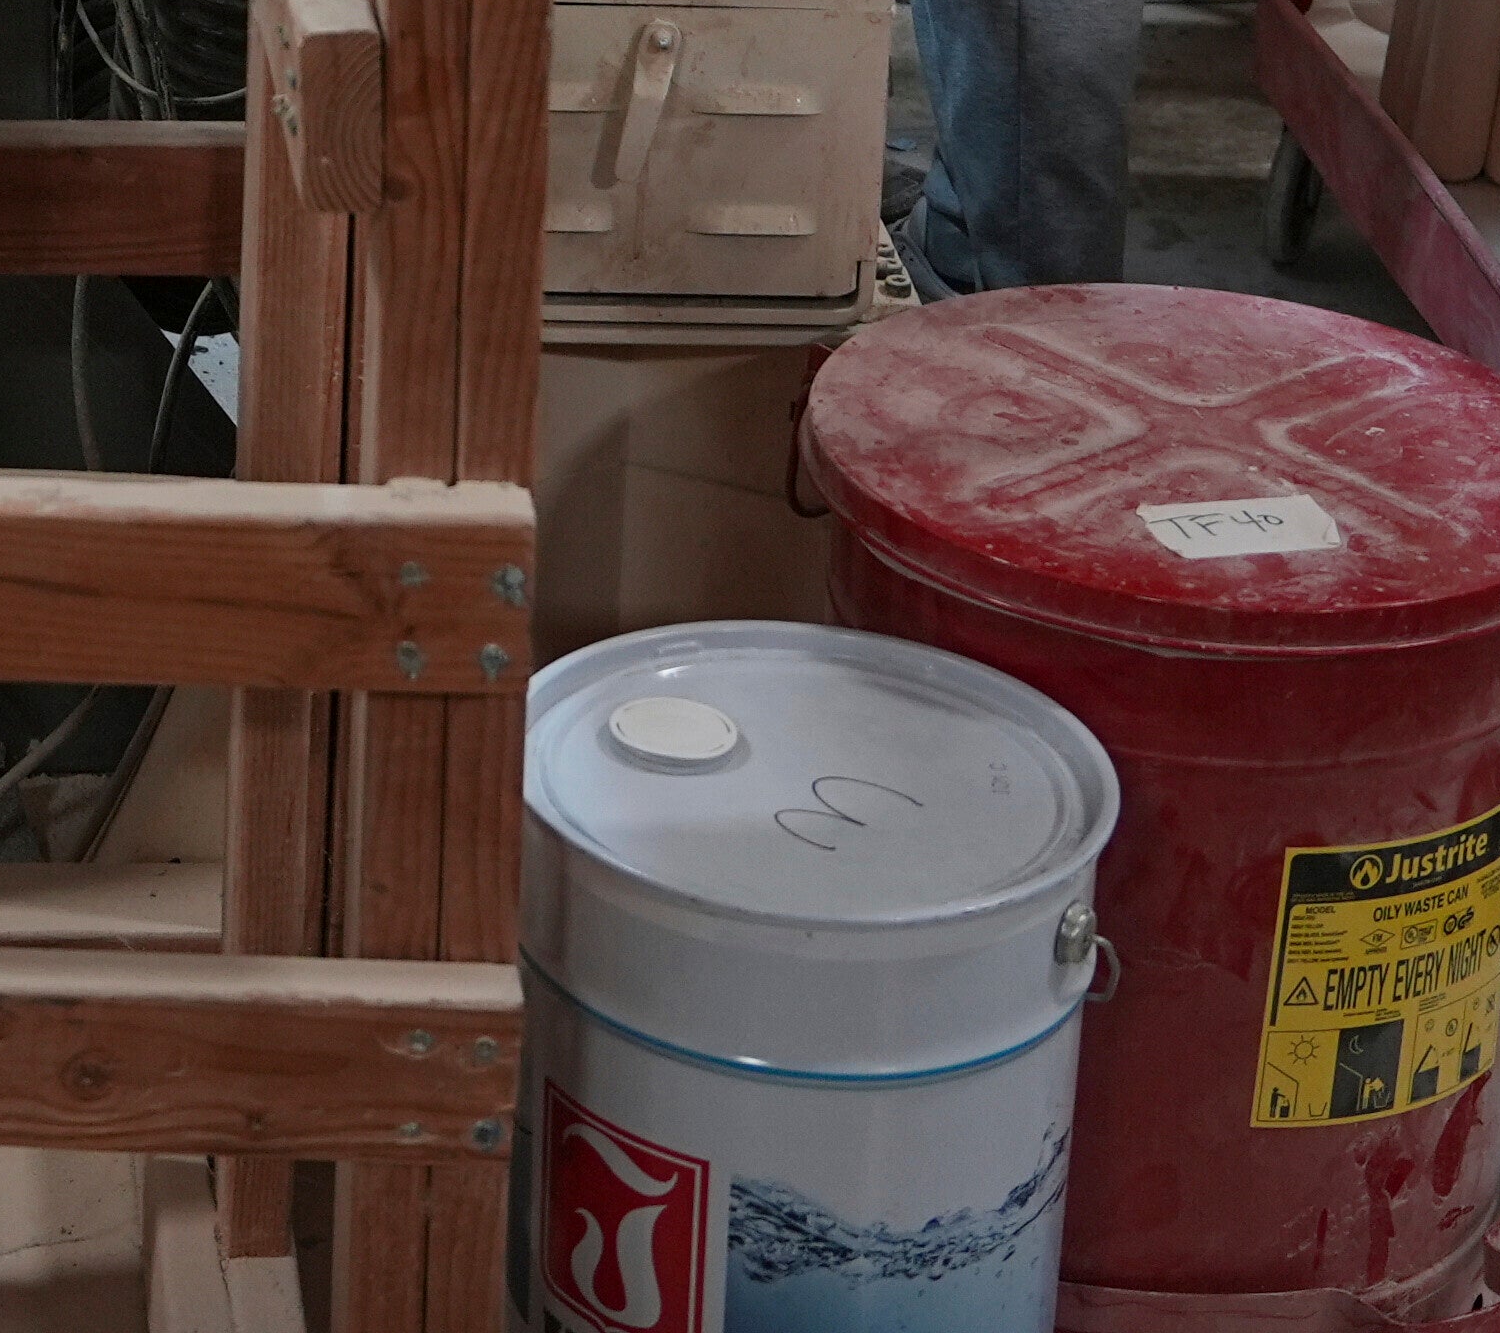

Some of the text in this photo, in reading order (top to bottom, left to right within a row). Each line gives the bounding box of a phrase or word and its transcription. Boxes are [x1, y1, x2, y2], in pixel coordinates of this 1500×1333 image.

[1385, 832, 1489, 884] Justrite
[1305, 905, 1337, 915] MODEL
[1373, 884, 1470, 923] OILY WASTE CAN
[1322, 962, 1391, 1012] EMPTY
[1392, 947, 1446, 1003] EVERY
[1446, 929, 1487, 987] NIGHT
